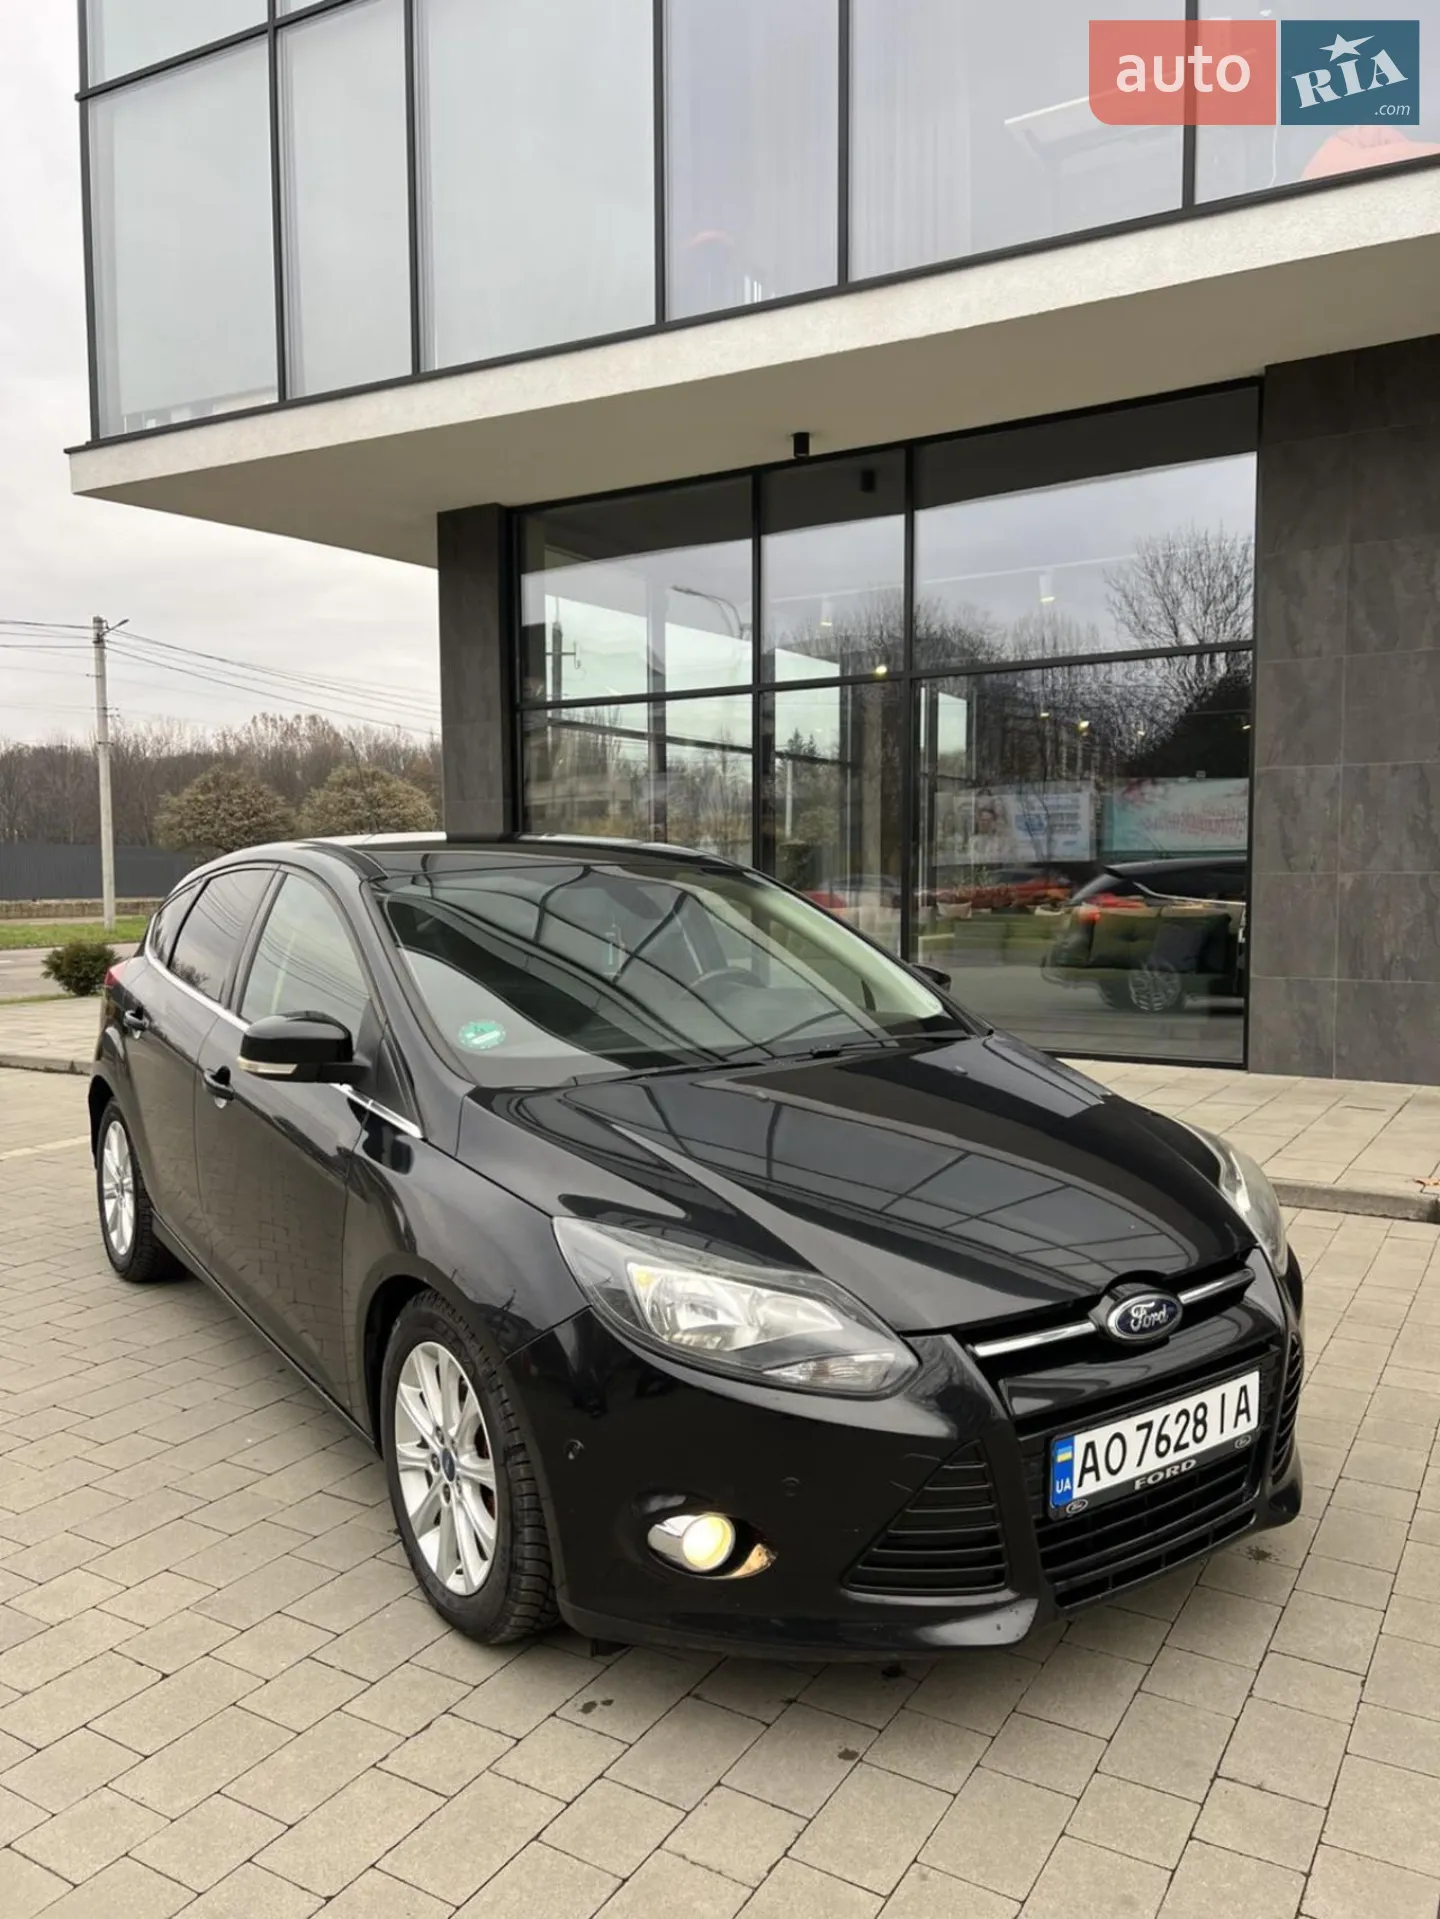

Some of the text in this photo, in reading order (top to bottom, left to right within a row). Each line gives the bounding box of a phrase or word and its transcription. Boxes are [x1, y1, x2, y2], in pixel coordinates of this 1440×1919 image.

[1130, 1301, 1169, 1332] Ford
[1077, 1384, 1251, 1488] AO 7628 IA
[1055, 1481, 1072, 1494] UA
[1134, 1458, 1197, 1490] FORD
